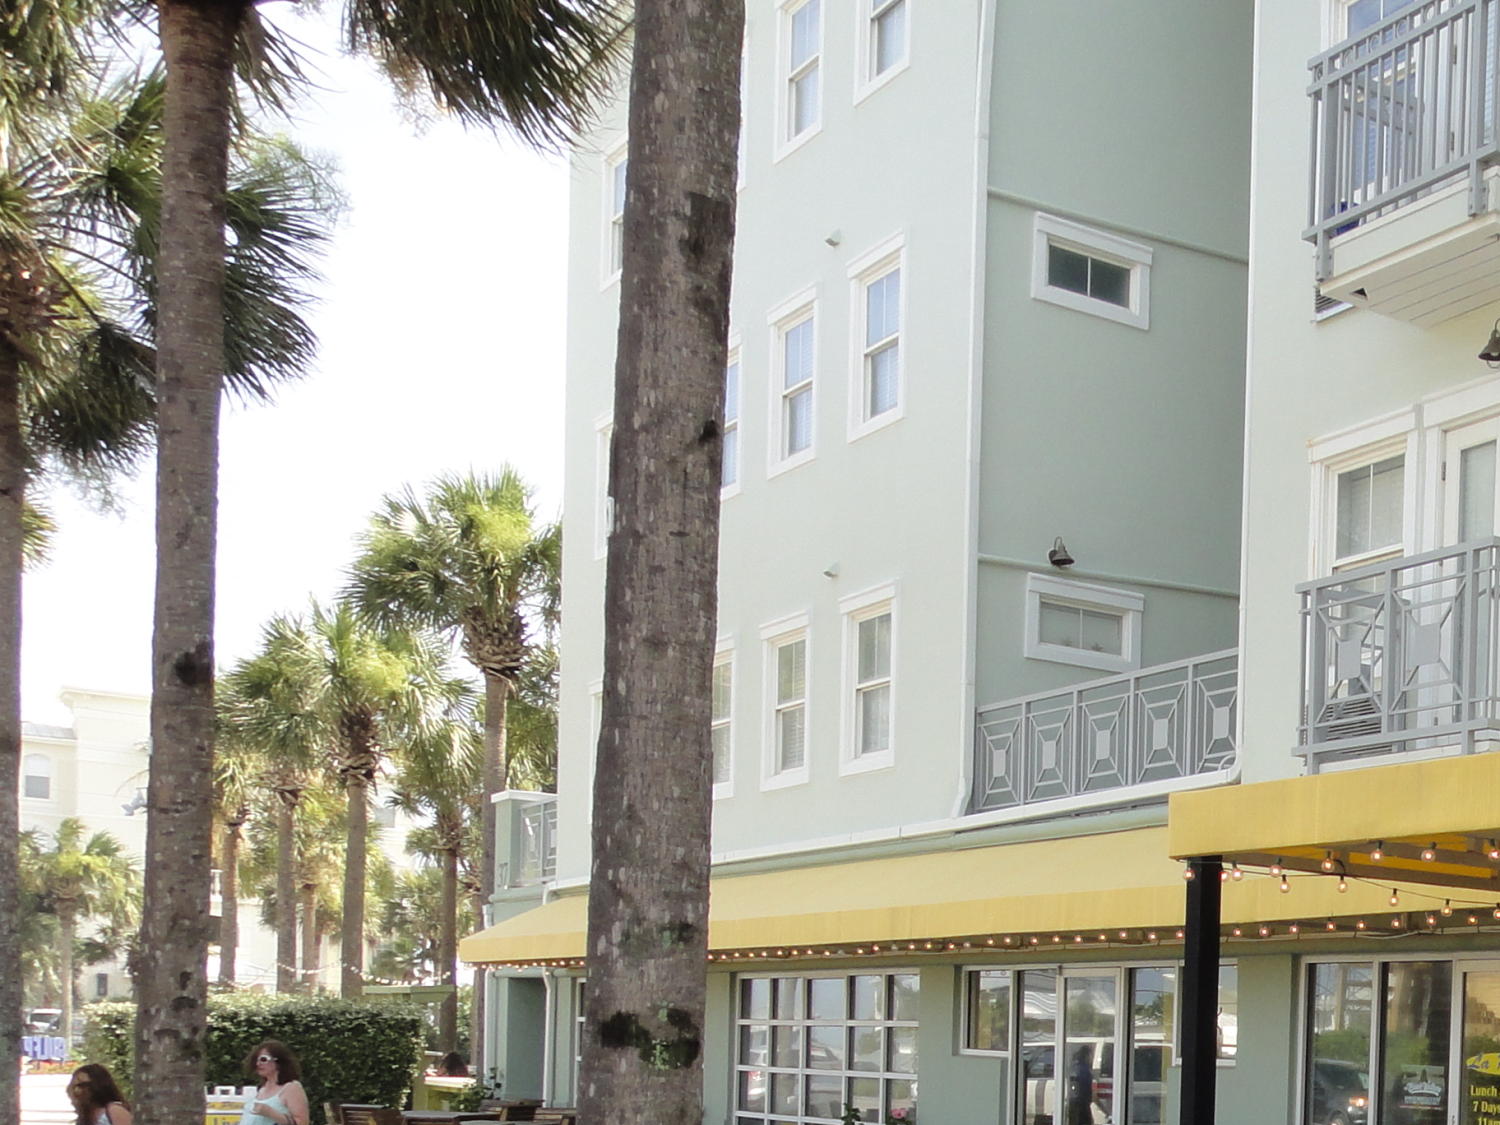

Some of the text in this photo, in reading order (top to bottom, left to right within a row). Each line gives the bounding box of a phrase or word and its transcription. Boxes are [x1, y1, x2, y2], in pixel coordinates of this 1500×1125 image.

[1466, 1052, 1489, 1070] La
[1470, 1085, 1497, 1097] Lunch
[1473, 1101, 1479, 1112] 7
